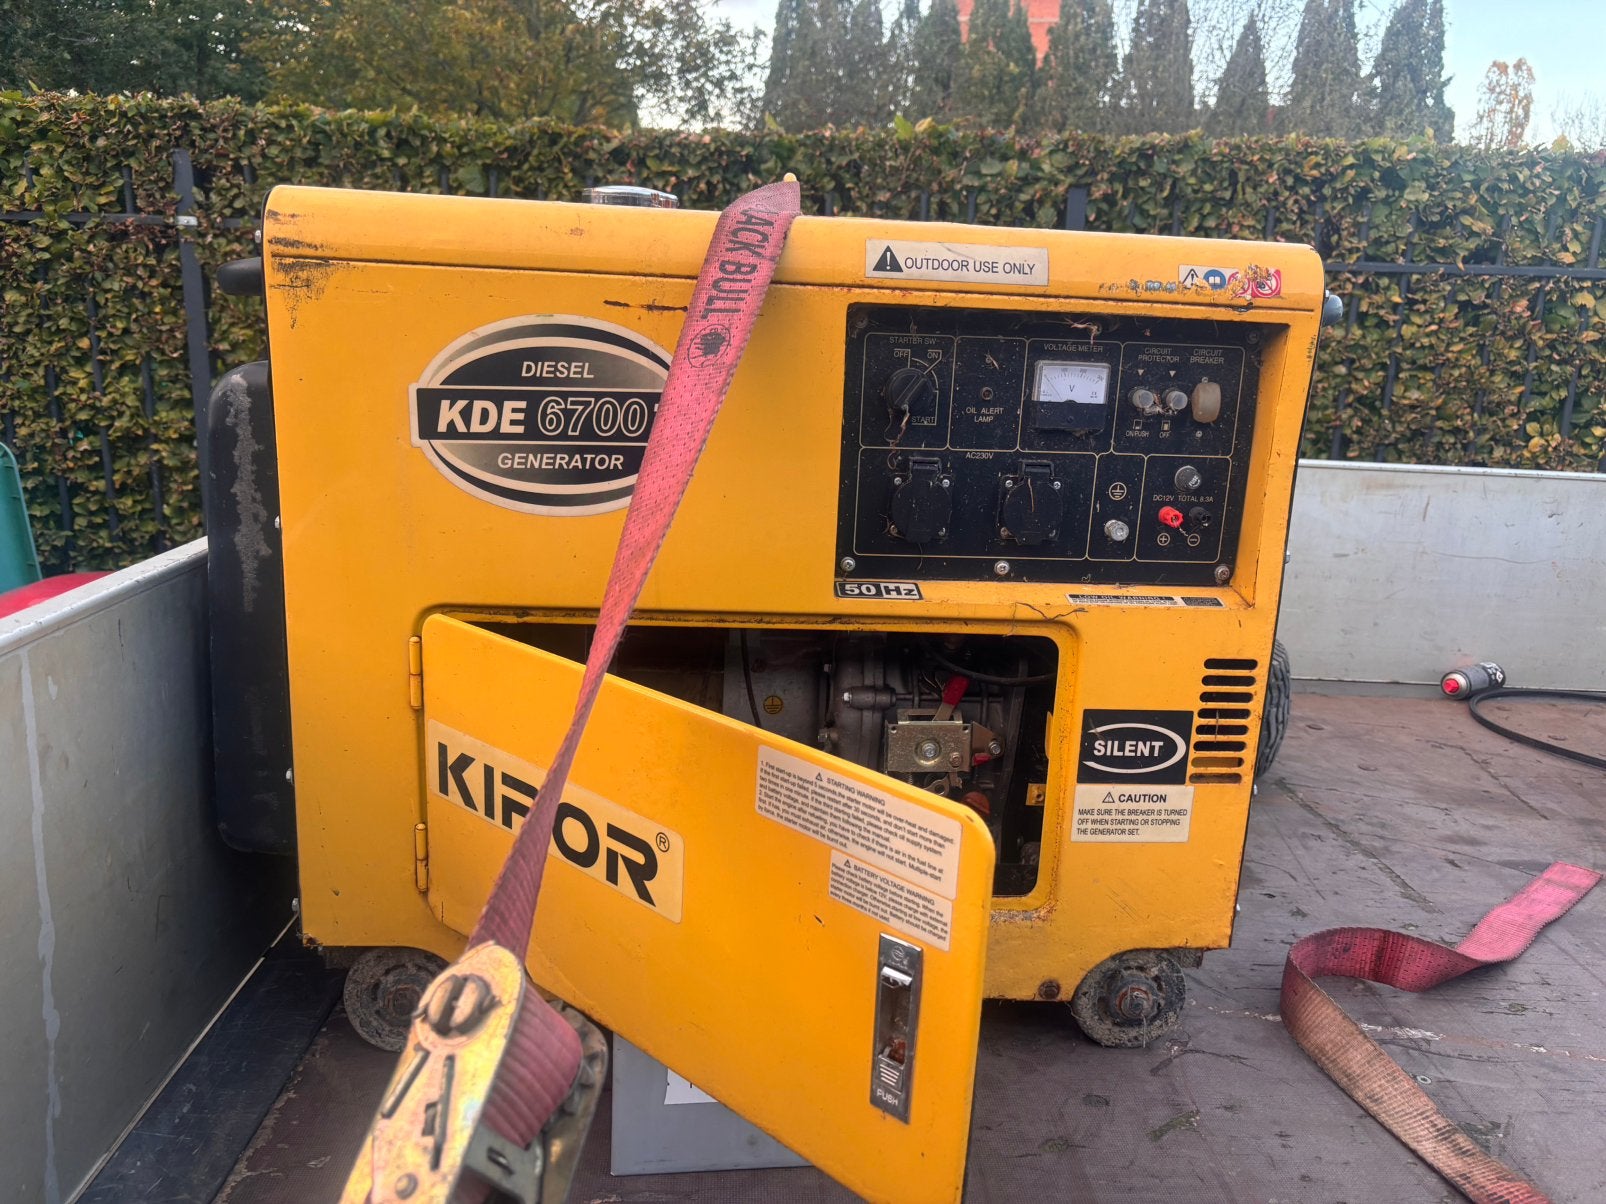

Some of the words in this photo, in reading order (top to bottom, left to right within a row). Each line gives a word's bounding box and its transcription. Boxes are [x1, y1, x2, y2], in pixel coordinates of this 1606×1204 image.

[905, 257, 969, 272] OUTDOOR
[973, 260, 999, 274] USE
[1003, 262, 1036, 275] ONLY
[701, 259, 758, 319] BULL
[1044, 343, 1077, 352] VOLTAGE
[1193, 348, 1222, 356] CIRCUIT
[1138, 354, 1180, 362] PROTECTOR
[1190, 356, 1224, 364] BREAKER
[522, 361, 594, 378] DIESEL
[1070, 384, 1075, 392] V
[437, 400, 528, 434] KDE
[538, 396, 659, 437] 6700
[497, 452, 624, 470] GENERATOR
[844, 584, 876, 595] 50
[882, 586, 917, 596] Hz
[1093, 740, 1164, 757] SILENT
[1118, 794, 1167, 804] CAUTION
[438, 741, 656, 907] KIPOR
[877, 1088, 898, 1106] PUSH
